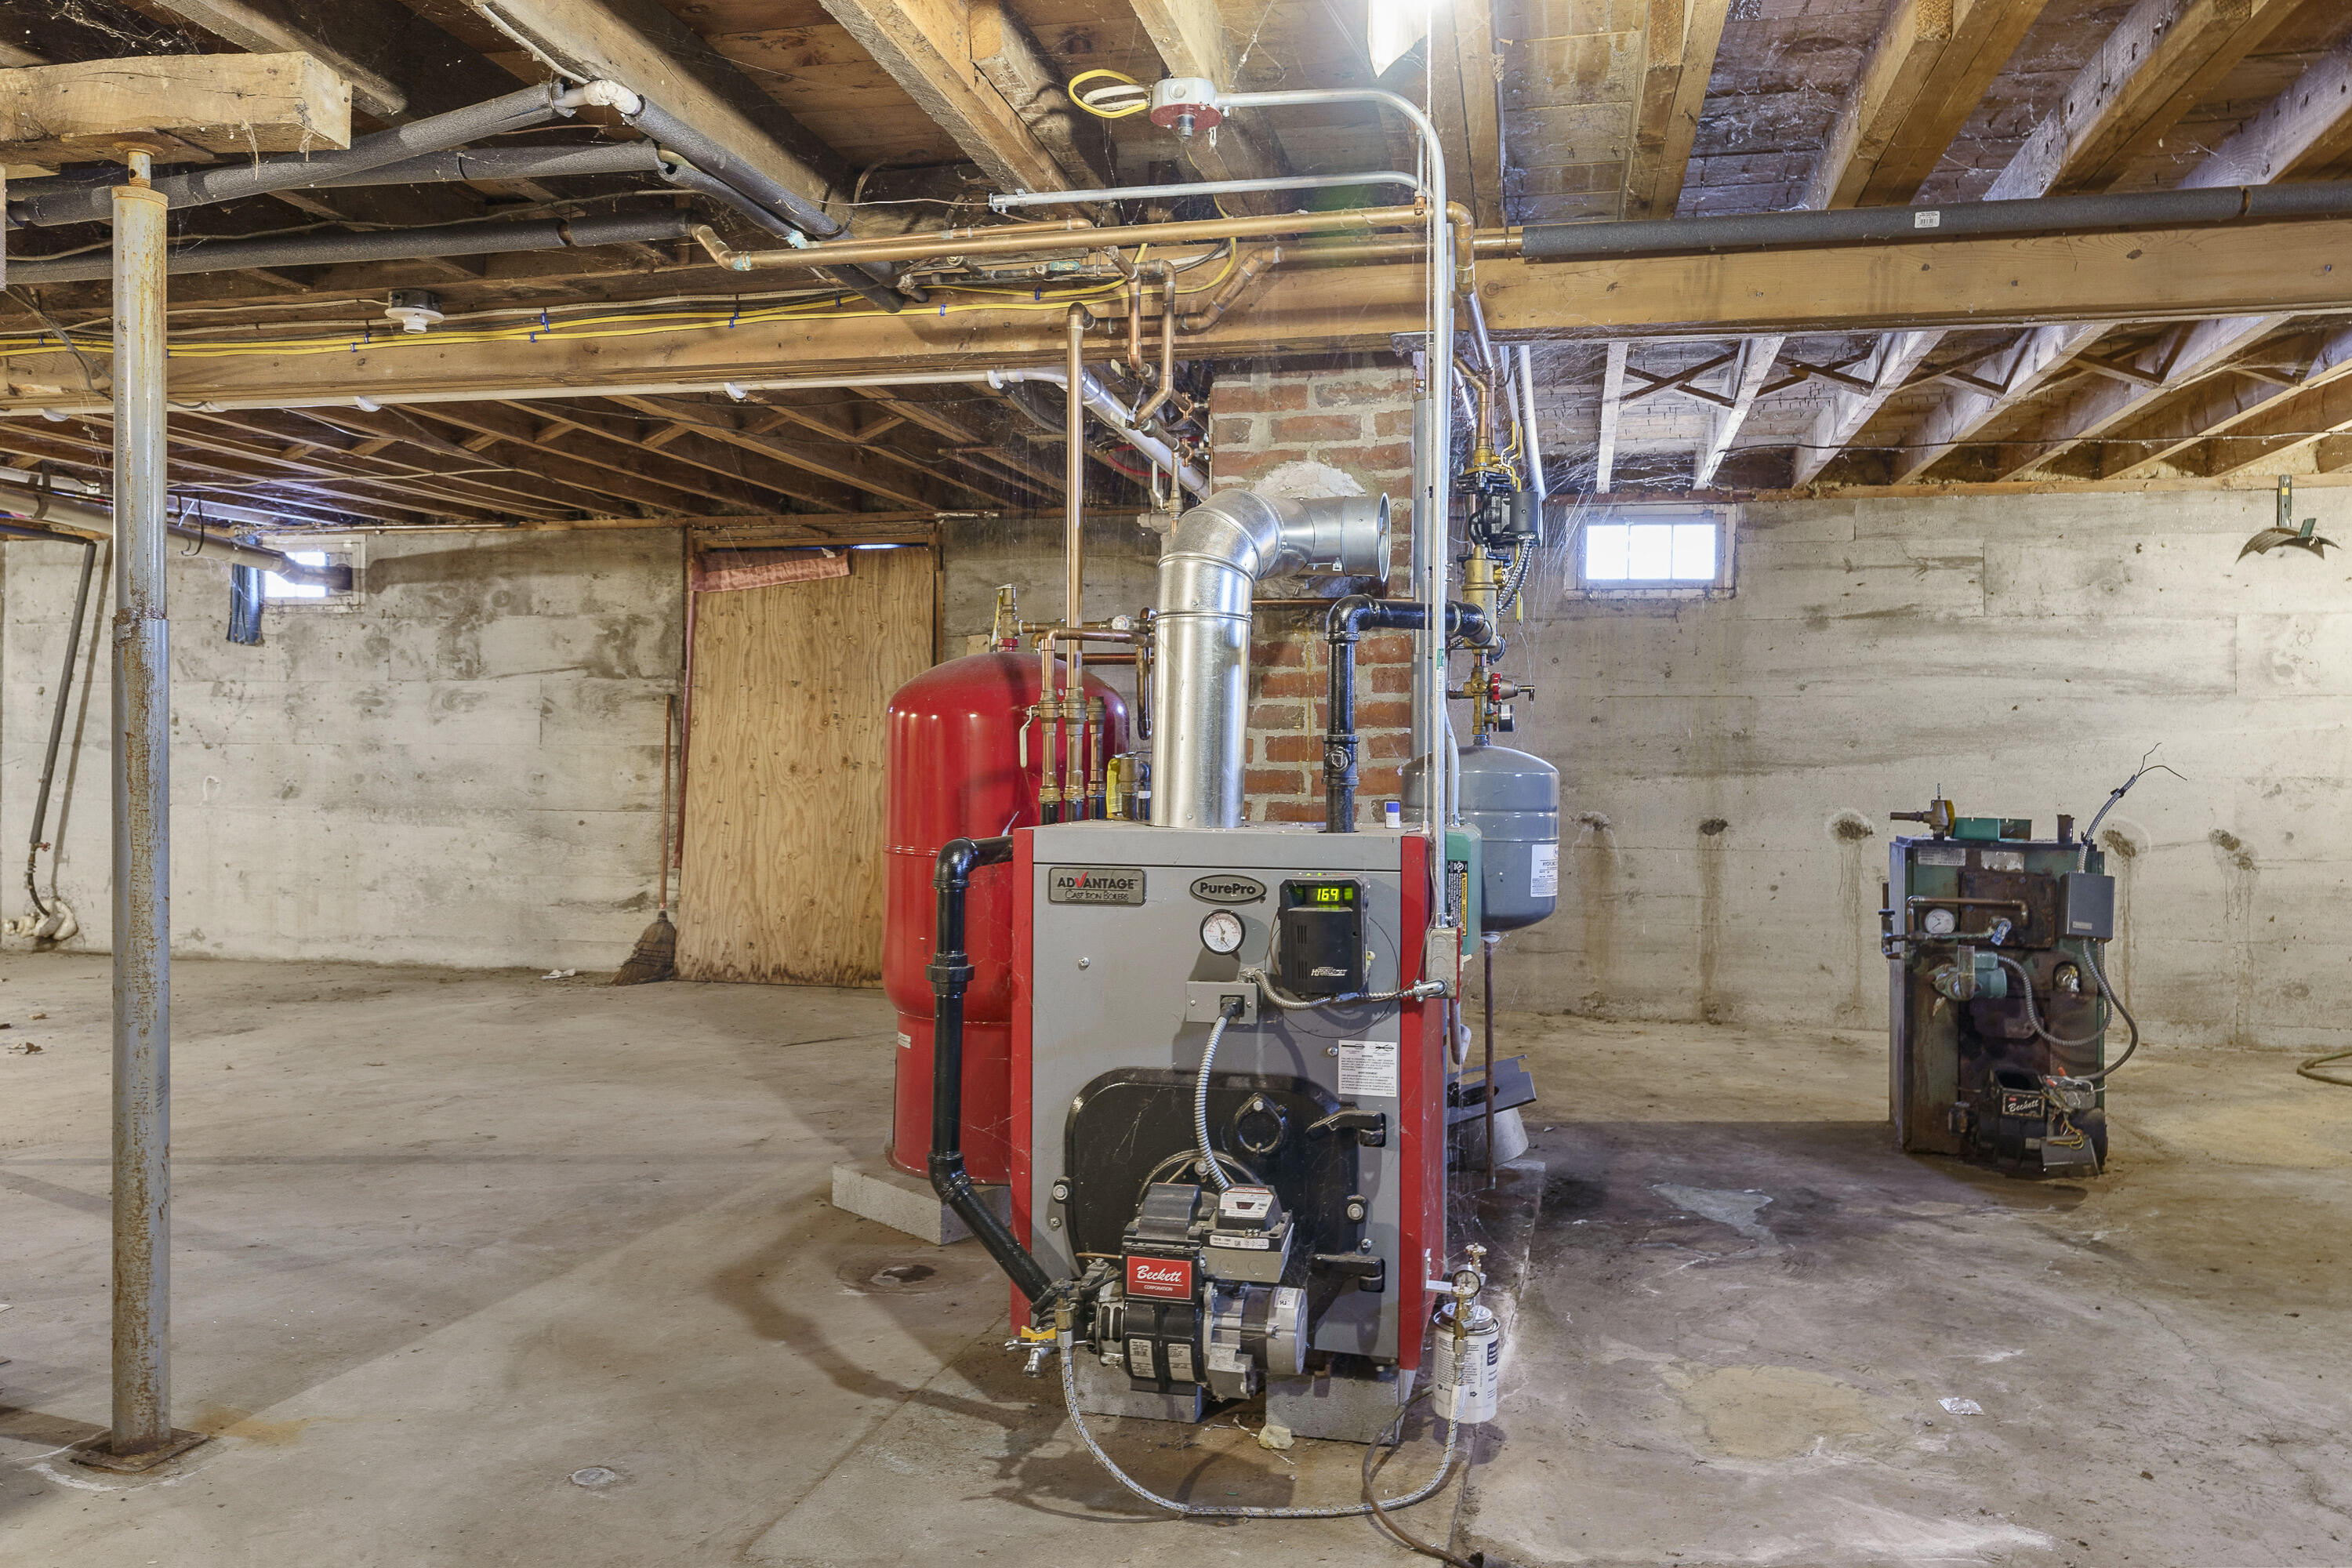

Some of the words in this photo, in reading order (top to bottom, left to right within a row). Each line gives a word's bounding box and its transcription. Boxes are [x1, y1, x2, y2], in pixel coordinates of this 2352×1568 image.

[1057, 871, 1135, 889] ADVANTAGE
[1200, 882, 1256, 895] PurePro
[1317, 888, 1339, 902] 169
[2008, 1099, 2039, 1112] Beckett
[1137, 1265, 1182, 1283] Beckett
